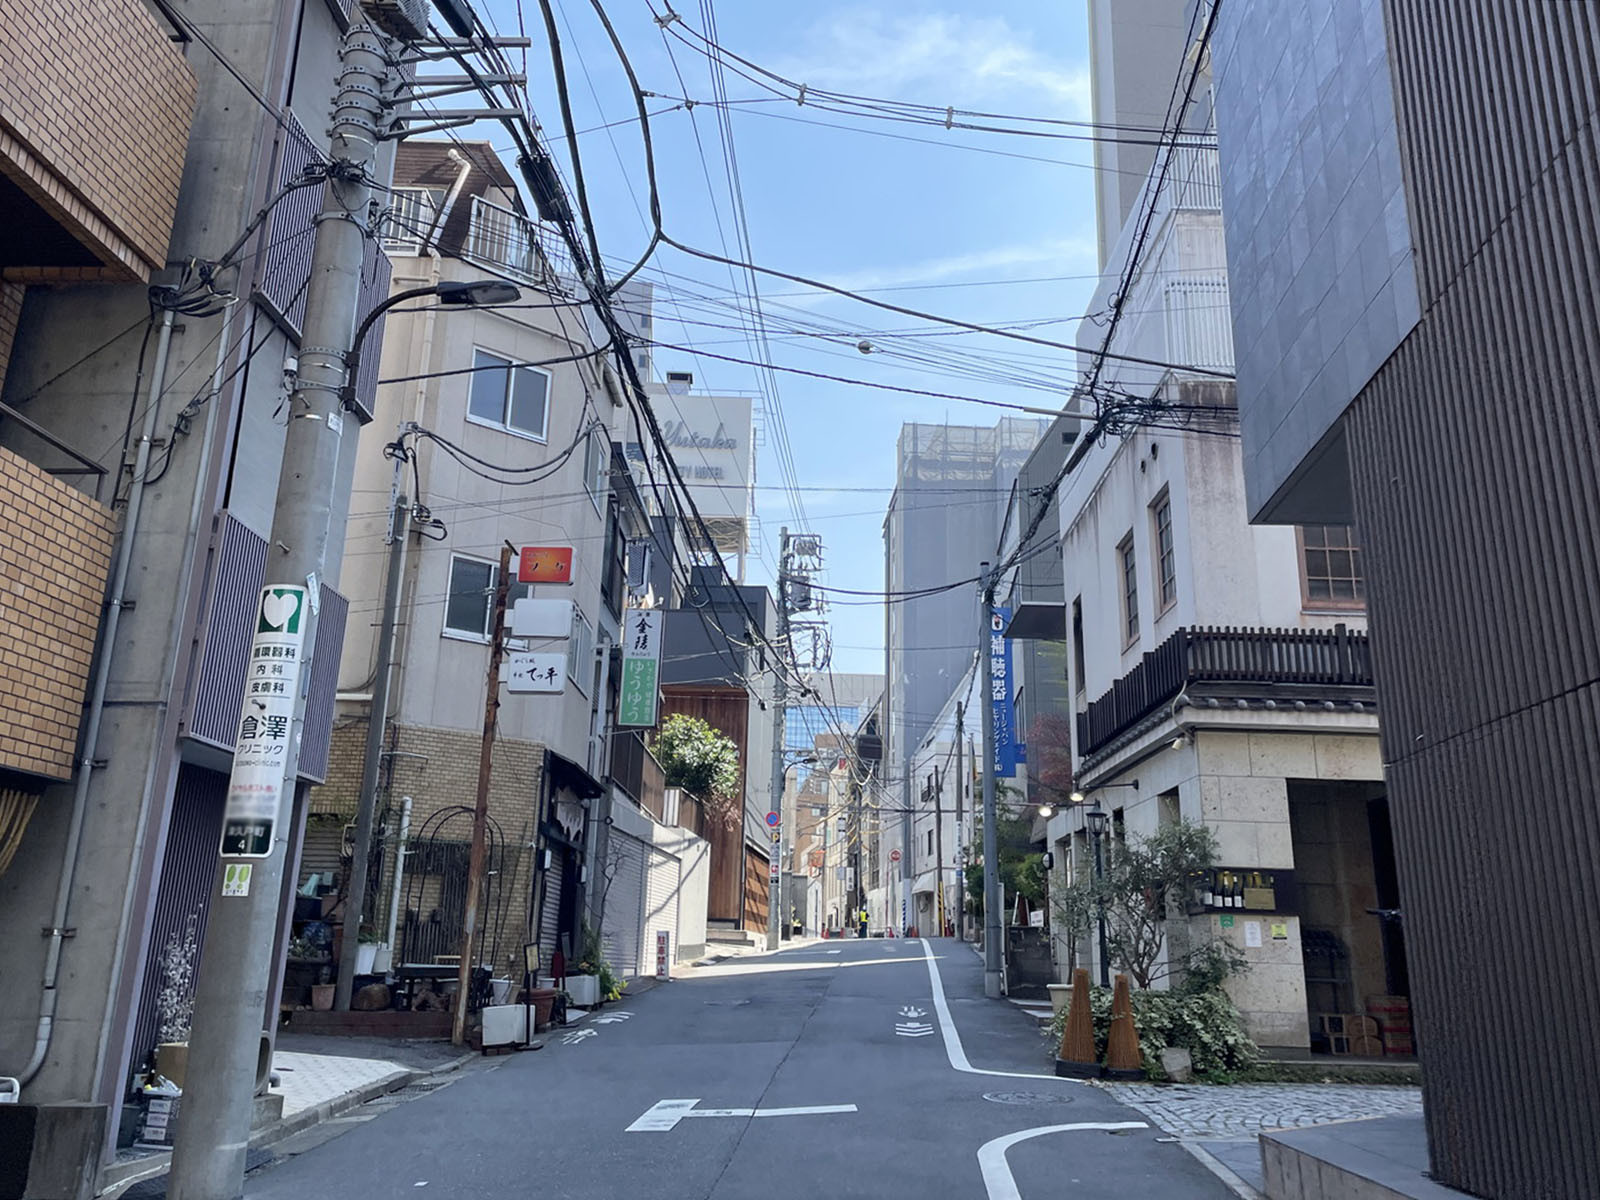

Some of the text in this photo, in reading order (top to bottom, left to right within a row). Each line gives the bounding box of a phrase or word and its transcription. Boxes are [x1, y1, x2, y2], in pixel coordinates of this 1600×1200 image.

[256, 664, 283, 675] 内科
[991, 634, 1006, 700] 補聴器
[251, 682, 284, 694] 皮膚科
[627, 661, 645, 721] ゆうゆう
[240, 714, 288, 740] 倉澤
[238, 744, 284, 755] クリニック
[238, 839, 246, 850] 4
